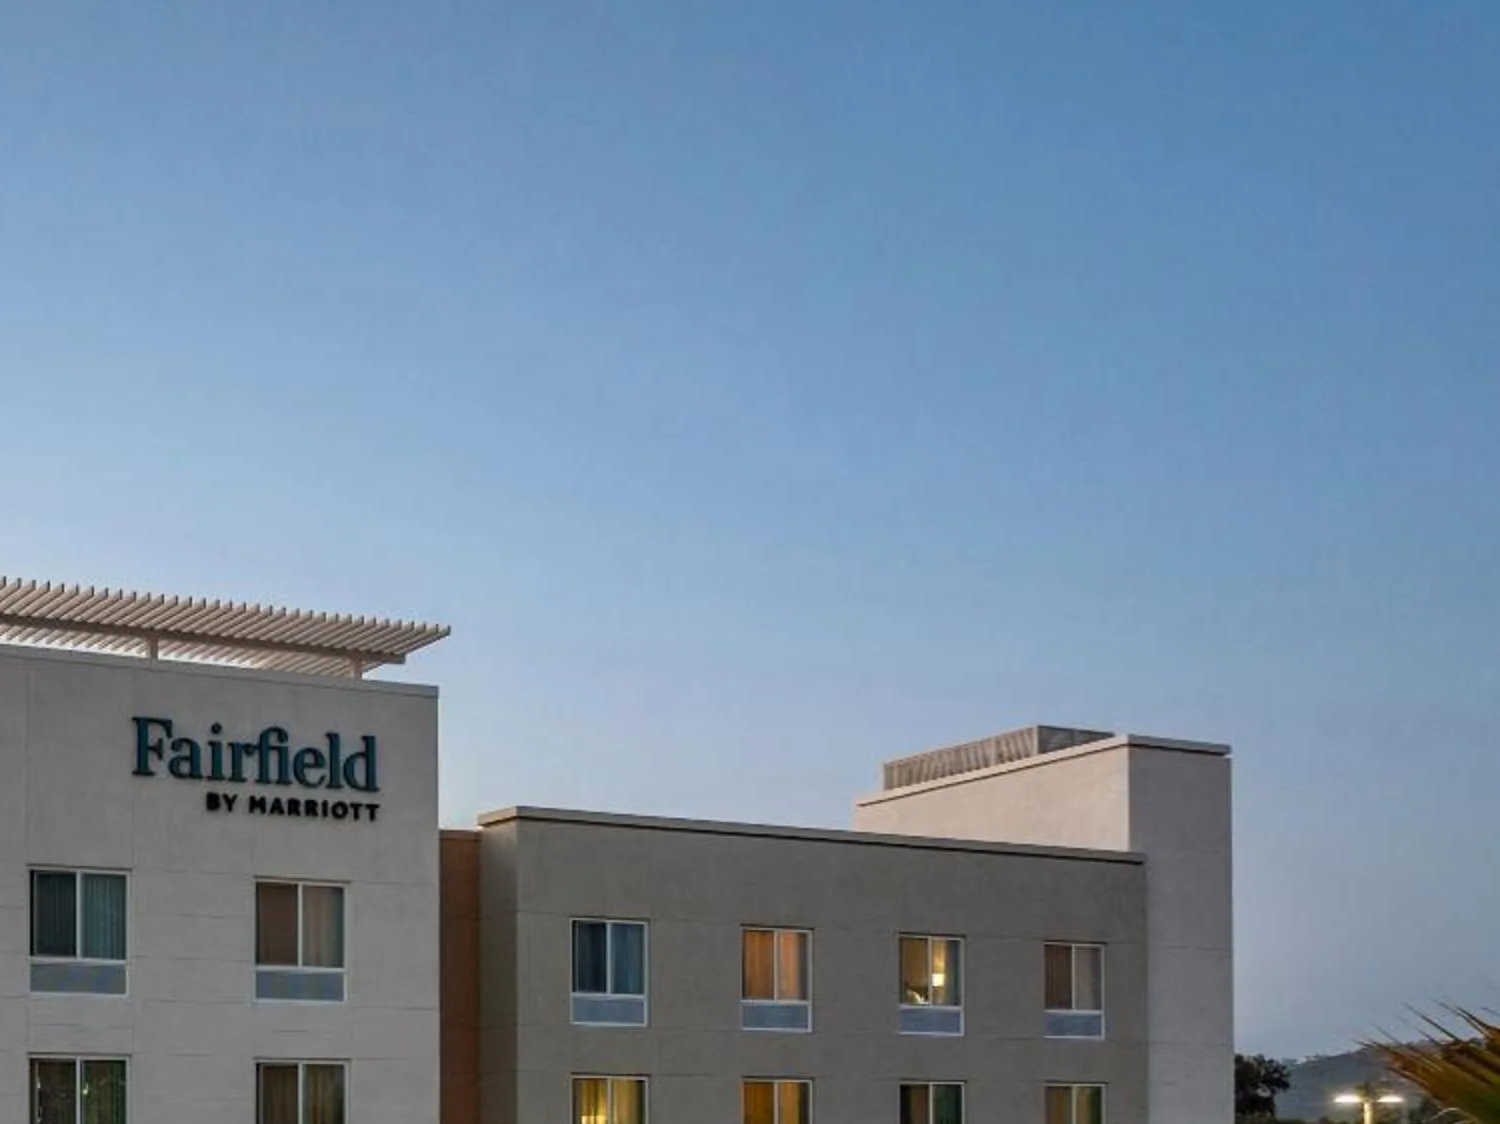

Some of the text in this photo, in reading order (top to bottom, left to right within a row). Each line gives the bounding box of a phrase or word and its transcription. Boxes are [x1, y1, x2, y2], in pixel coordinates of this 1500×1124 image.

[132, 716, 380, 792] Fairfield
[206, 792, 380, 821] BY MARRIOTT
